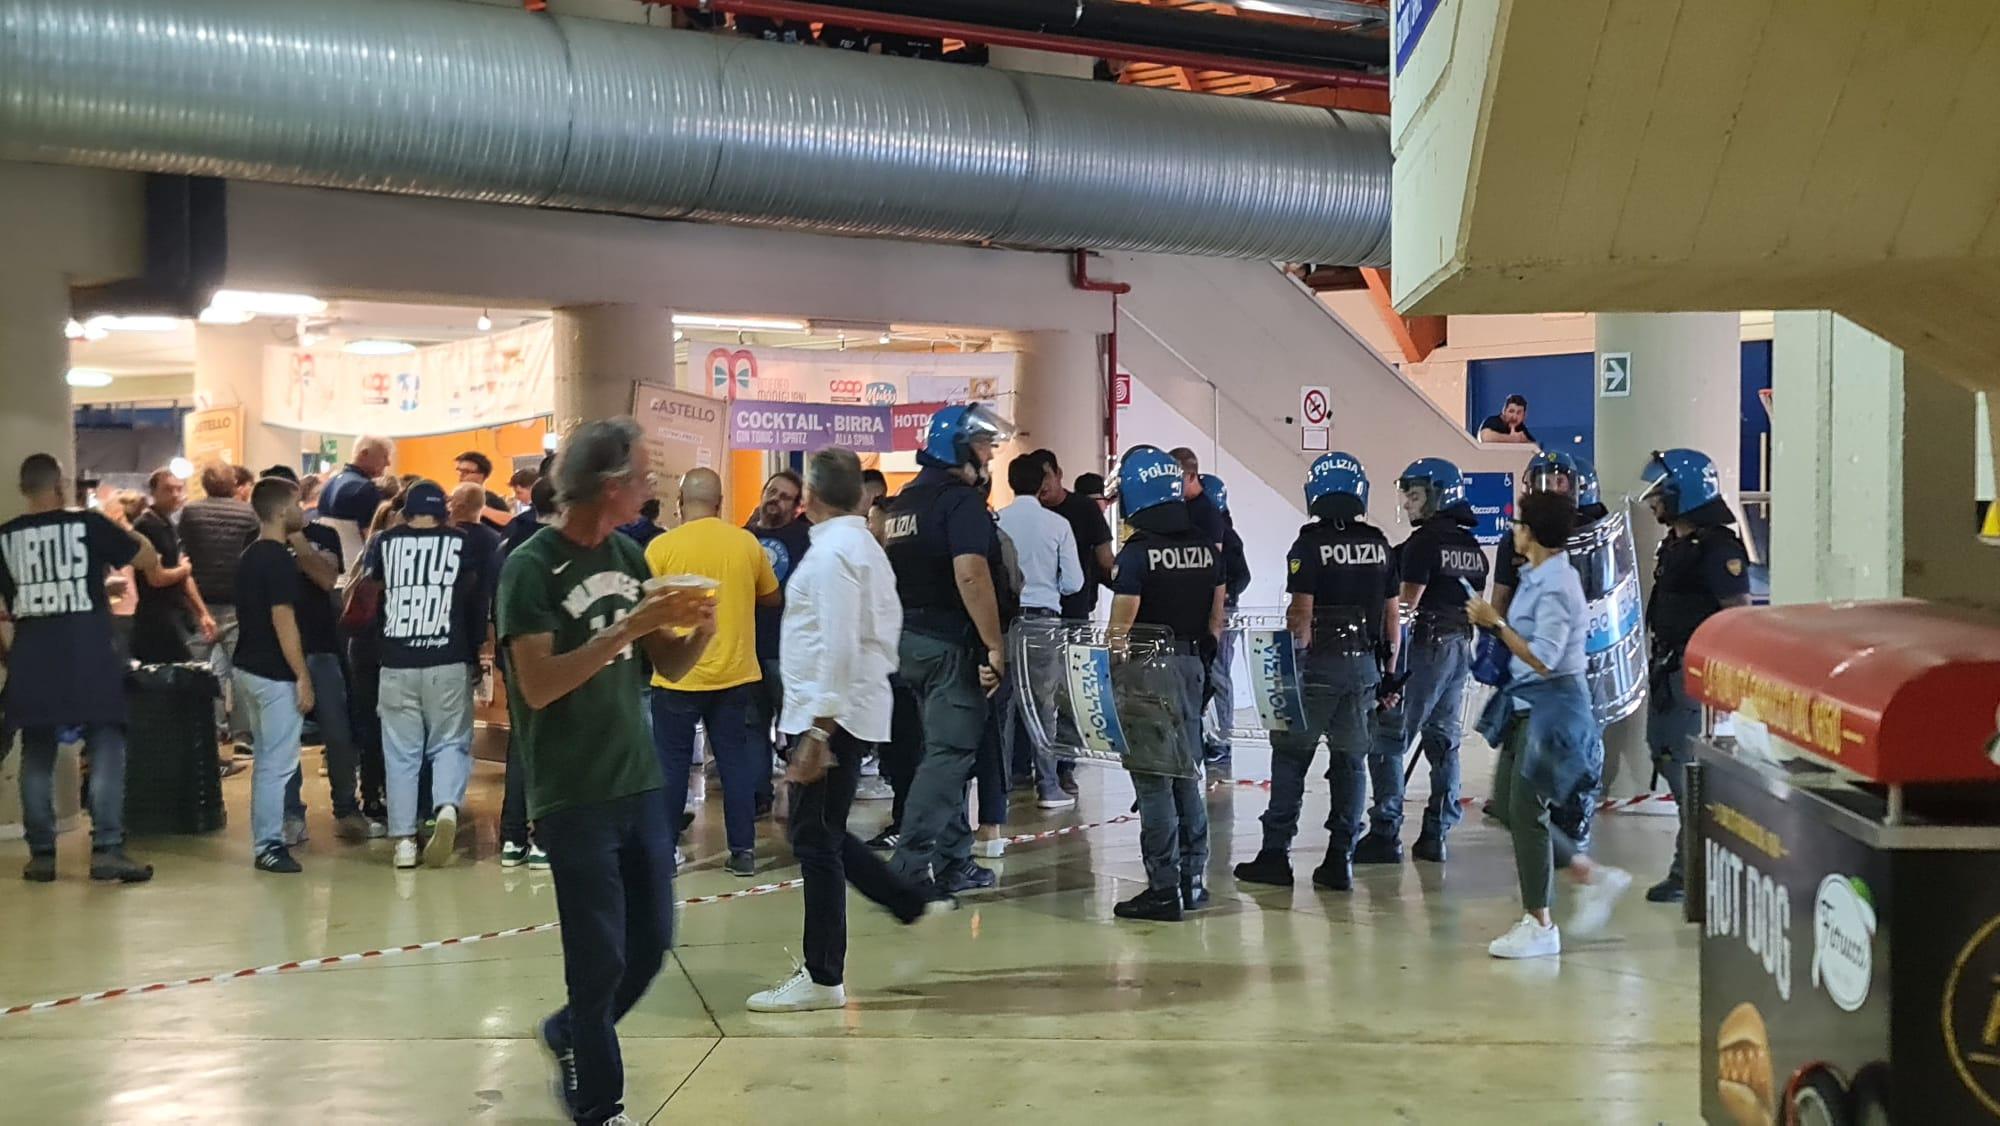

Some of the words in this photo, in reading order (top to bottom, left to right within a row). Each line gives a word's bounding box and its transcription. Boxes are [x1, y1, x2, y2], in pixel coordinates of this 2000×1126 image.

[830, 379, 863, 395] coop
[737, 410, 823, 431] COCKTAIL
[834, 414, 885, 432] BIRRA
[782, 432, 807, 445] SPRITZ
[834, 434, 852, 446] ALLA
[853, 435, 875, 447] SPINA
[1314, 459, 1359, 476] POLIZIA
[1, 522, 89, 585] VIRTUS
[382, 536, 463, 589] VIRTUS
[1148, 546, 1214, 571] POLIZIA
[1320, 543, 1387, 566] POLIZIA
[1441, 549, 1484, 572] POLIZIA
[383, 585, 453, 638] MERDA
[1081, 659, 1114, 742] POLIZIA
[1705, 838, 1743, 938] HOT
[1746, 865, 1791, 1000] DOG
